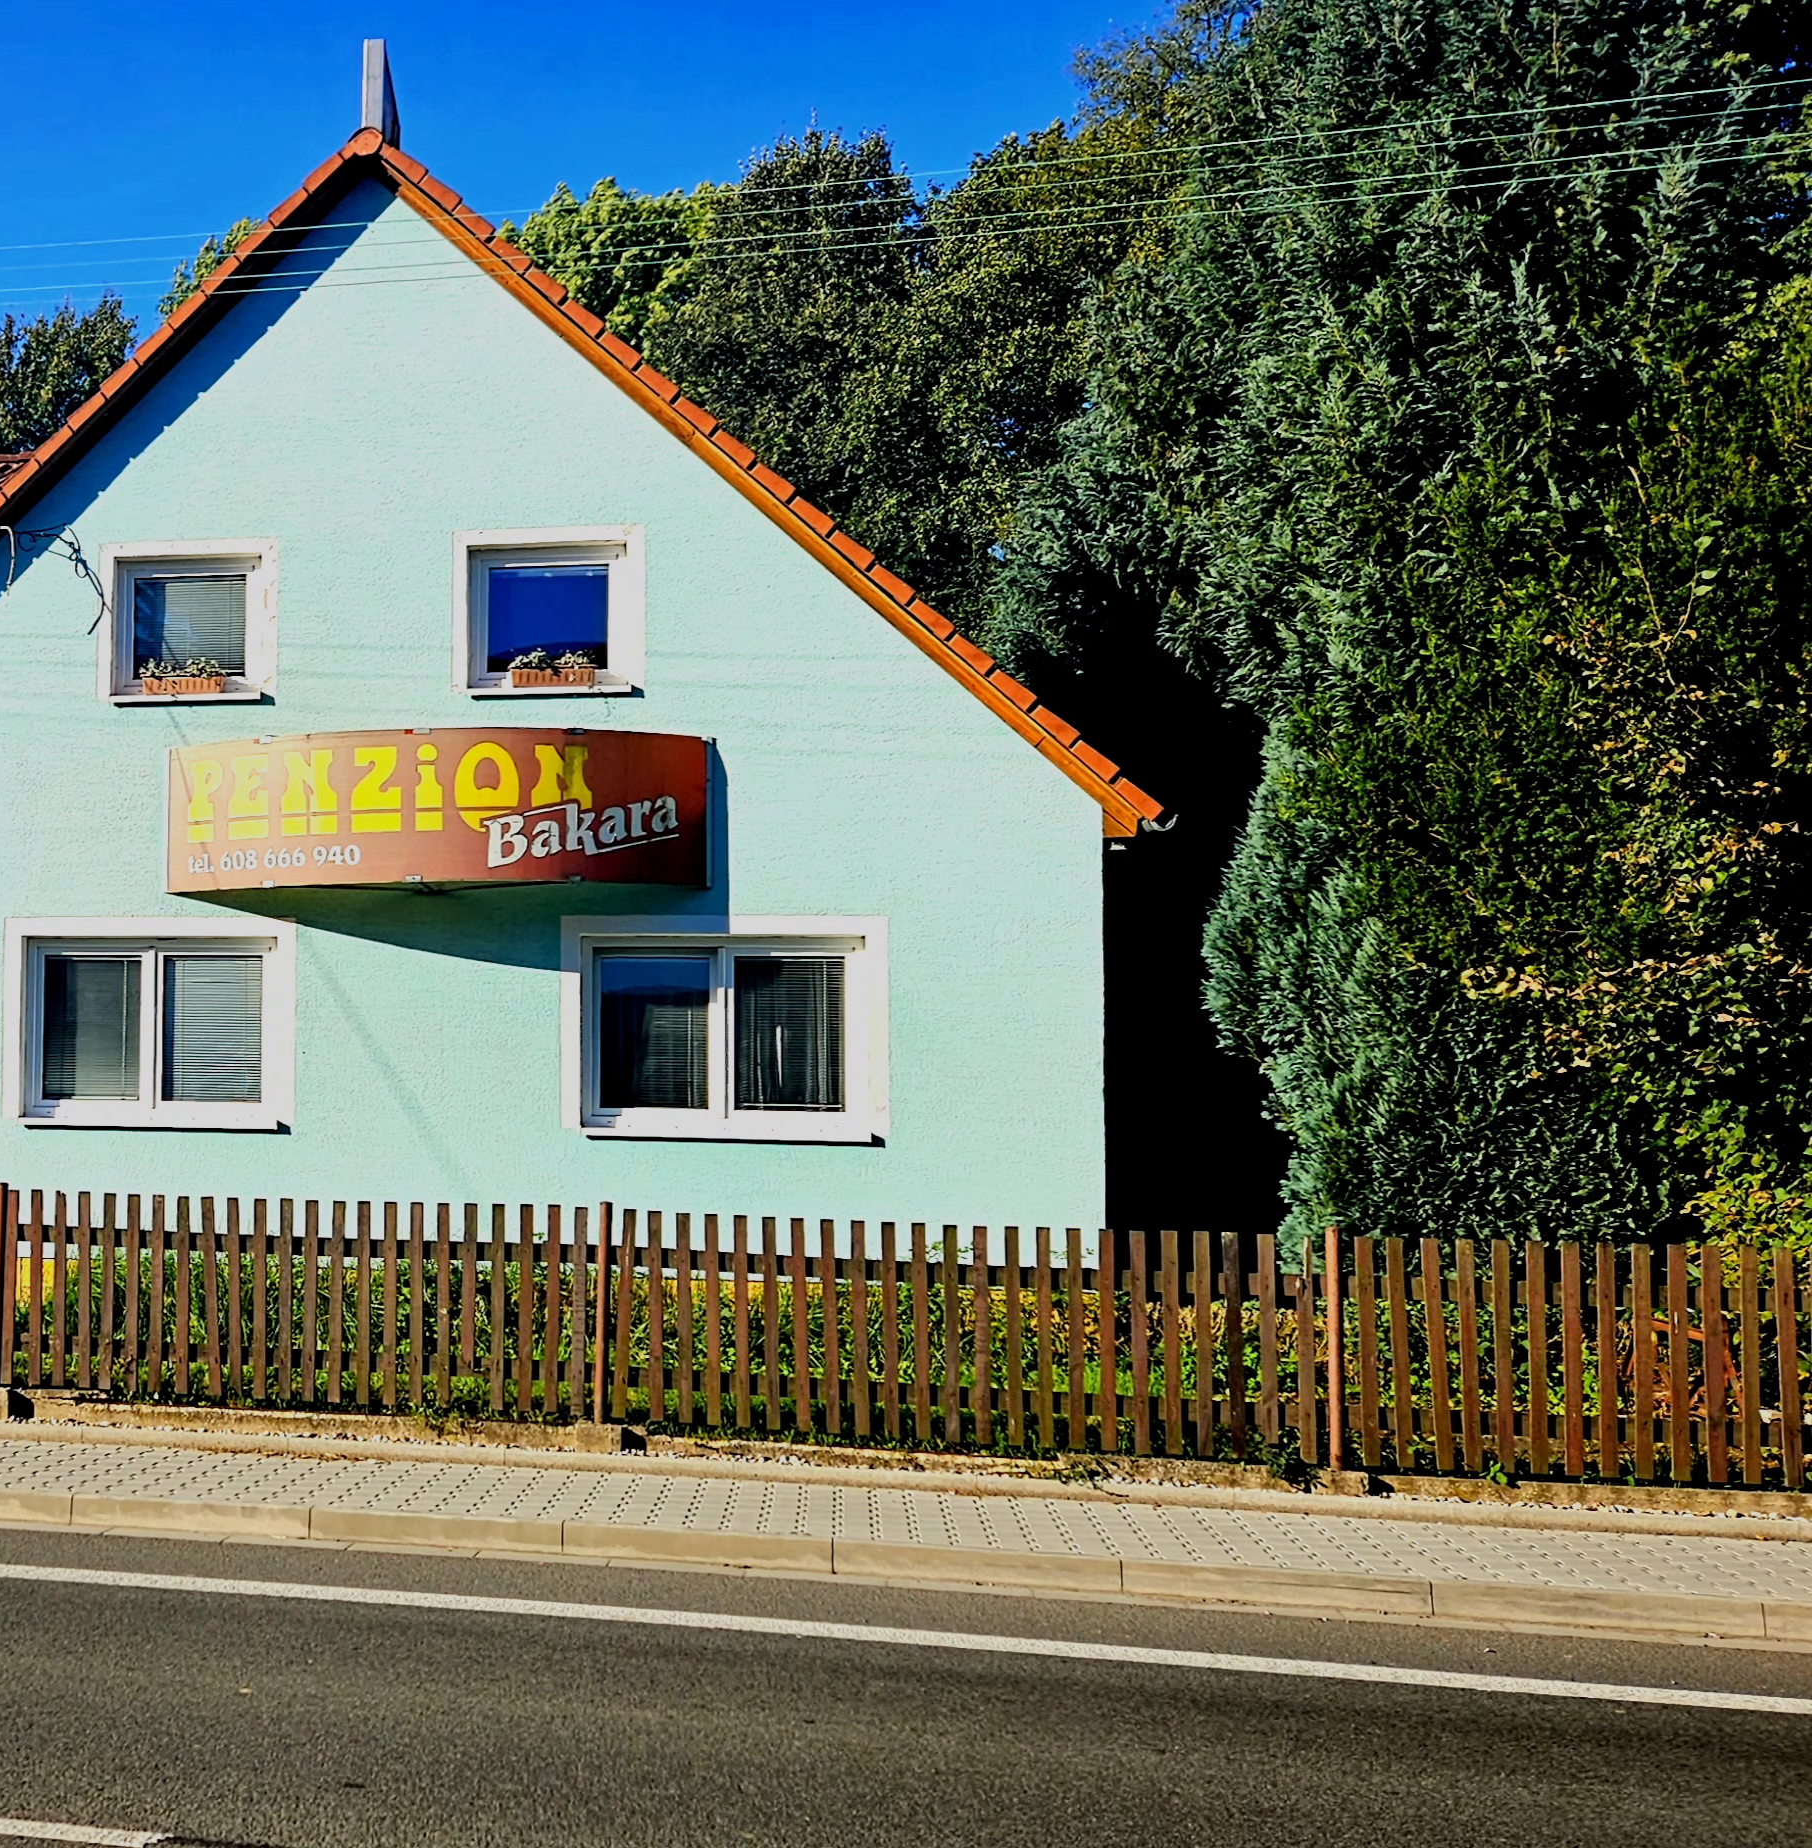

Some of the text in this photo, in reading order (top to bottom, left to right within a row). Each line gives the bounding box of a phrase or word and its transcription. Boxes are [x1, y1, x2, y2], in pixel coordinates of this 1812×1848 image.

[486, 795, 679, 868] Bakara
[187, 844, 361, 874] tel. 608 666 940
